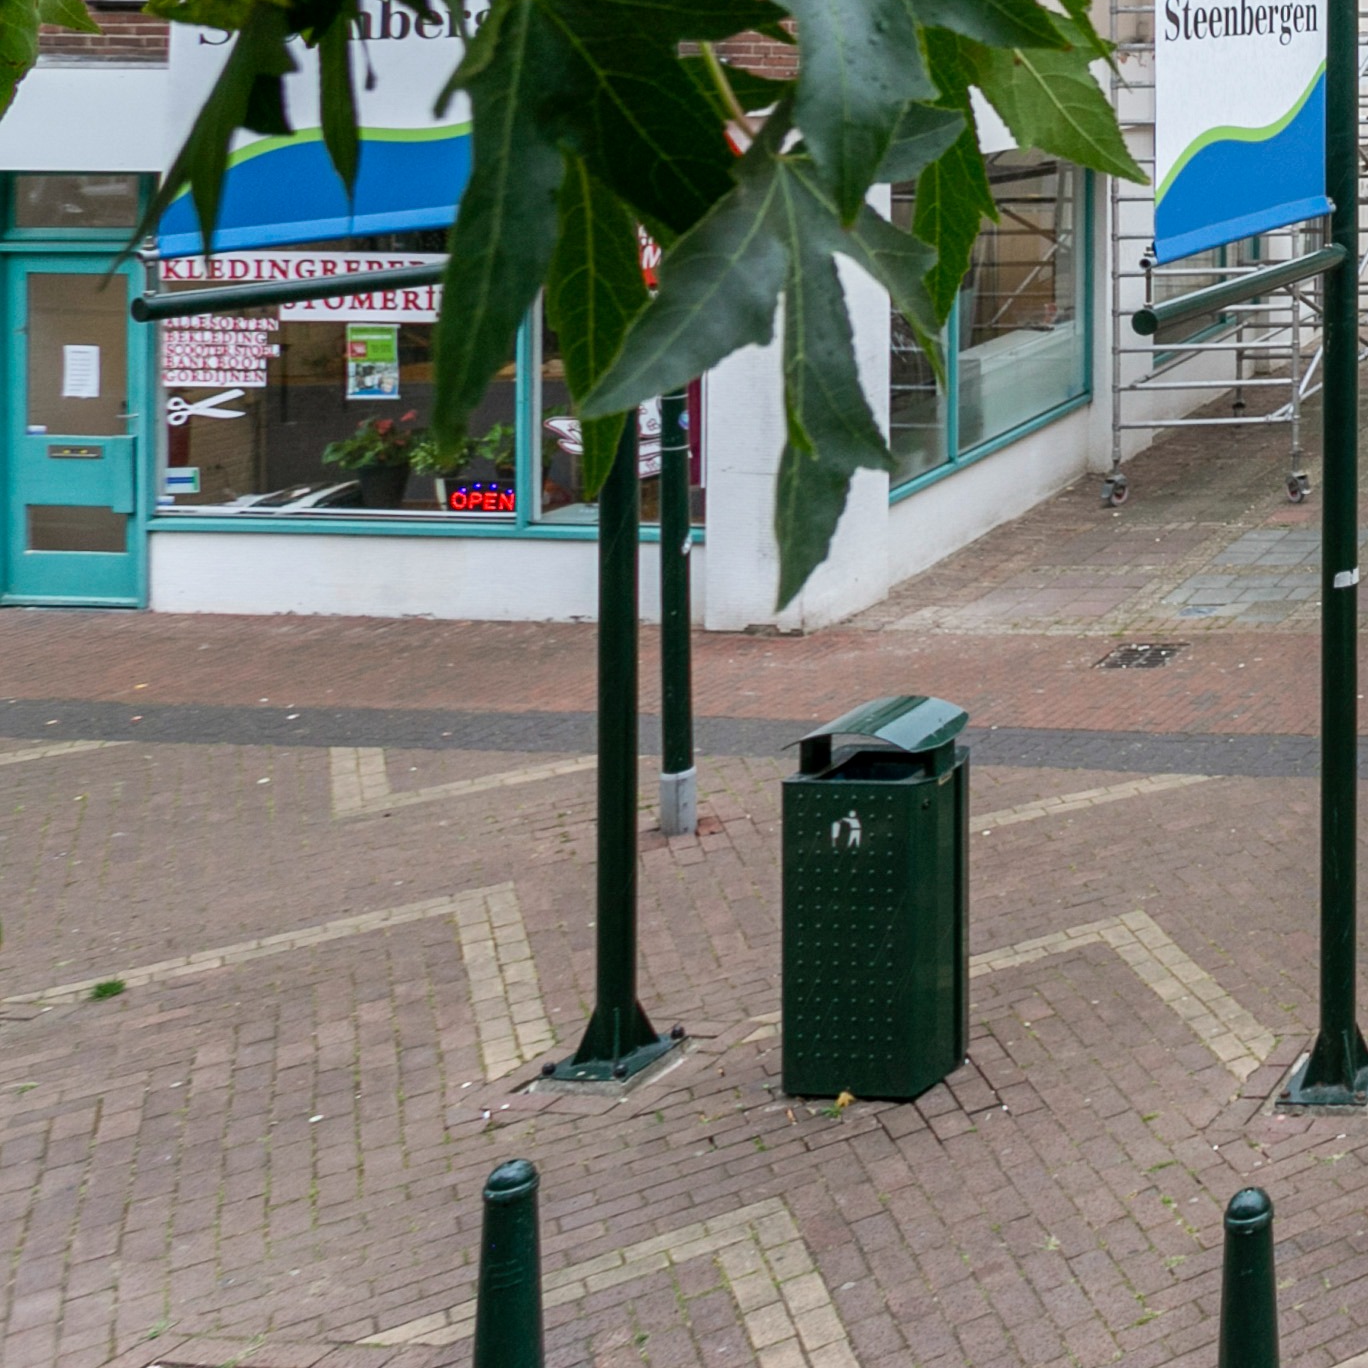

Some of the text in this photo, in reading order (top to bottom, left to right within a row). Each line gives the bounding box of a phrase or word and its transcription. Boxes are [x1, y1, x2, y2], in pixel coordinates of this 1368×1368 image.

[166, 331, 267, 344] BEKLEDING
[166, 356, 210, 369] BANK
[165, 370, 265, 385] GORDIJNEN
[450, 492, 515, 511] OPEN
